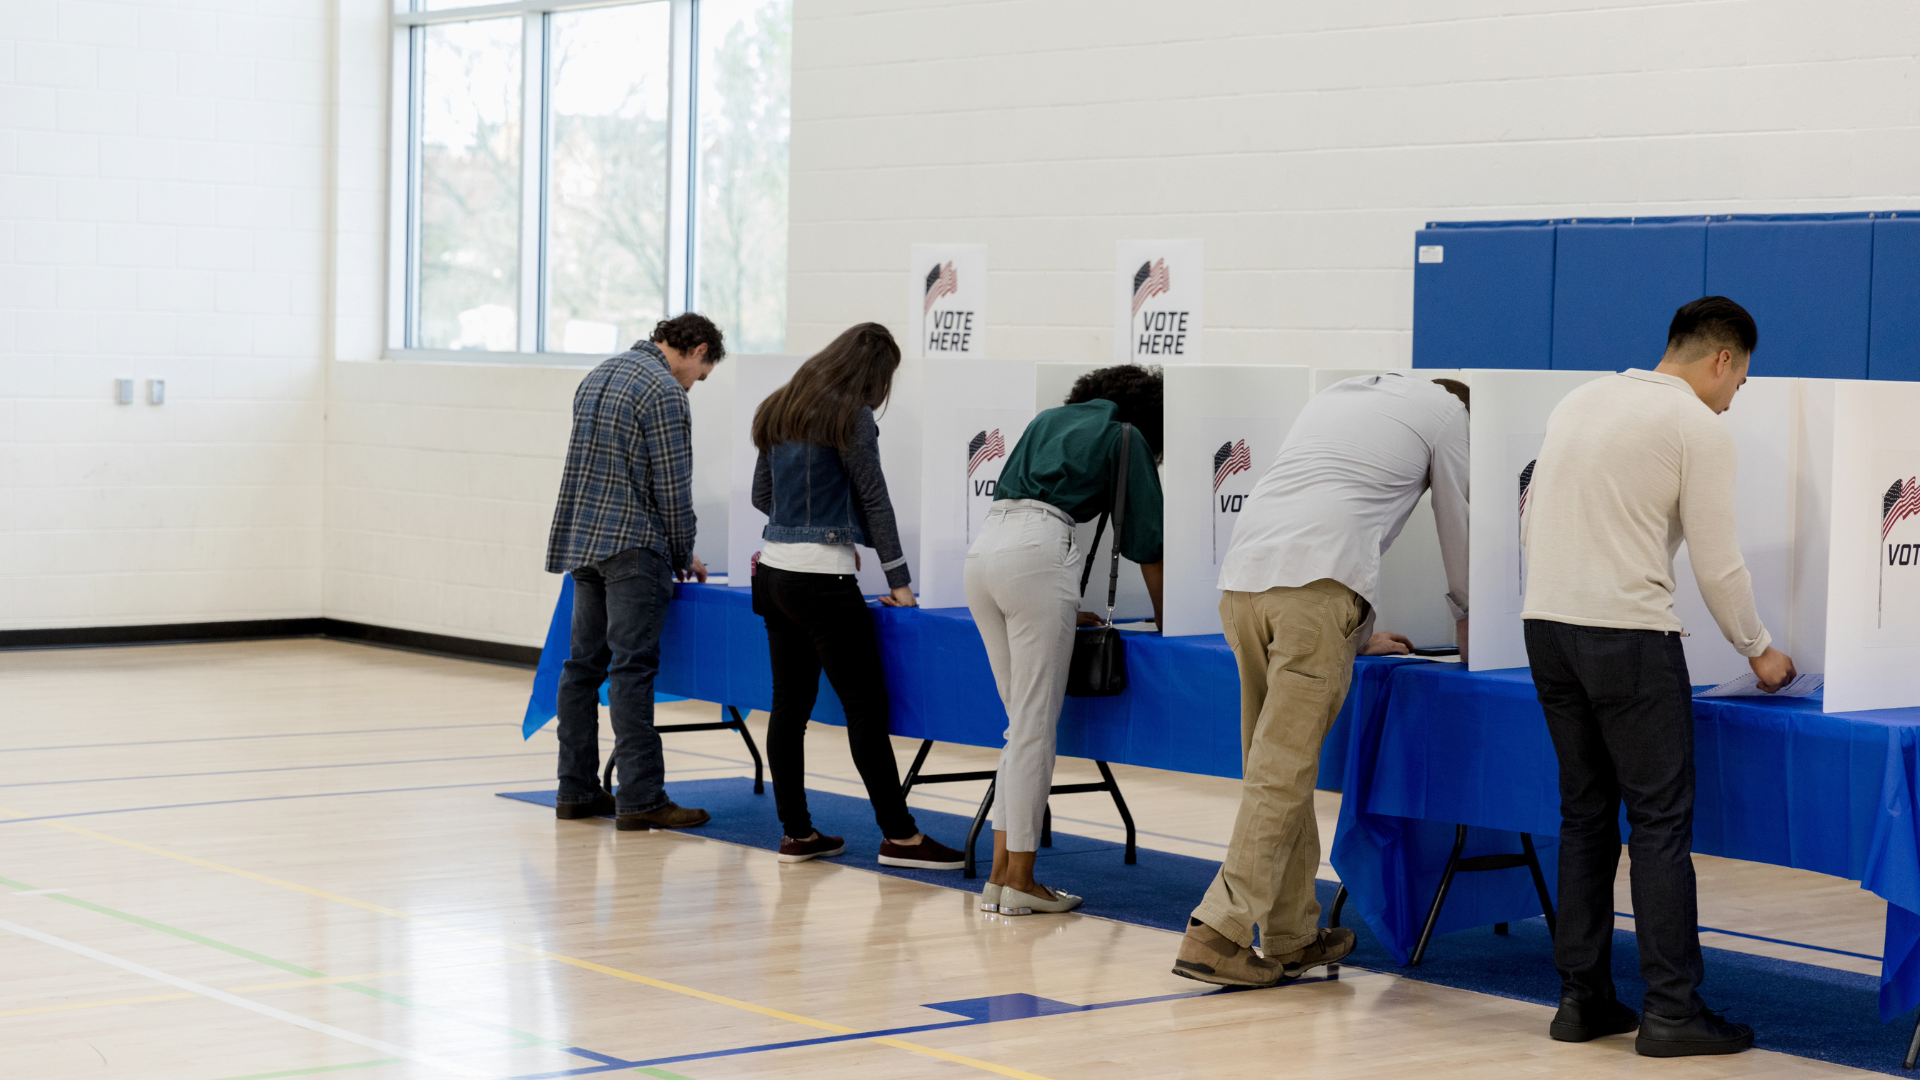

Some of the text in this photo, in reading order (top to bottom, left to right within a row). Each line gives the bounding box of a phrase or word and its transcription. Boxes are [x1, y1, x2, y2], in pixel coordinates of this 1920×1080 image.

[934, 310, 974, 331] VOTE
[1144, 311, 1189, 331] VOTE
[929, 332, 971, 351] HERE
[1138, 334, 1186, 354] HERE
[975, 480, 996, 496] VO
[1220, 494, 1249, 513] VO
[1889, 544, 1920, 565] VOT
